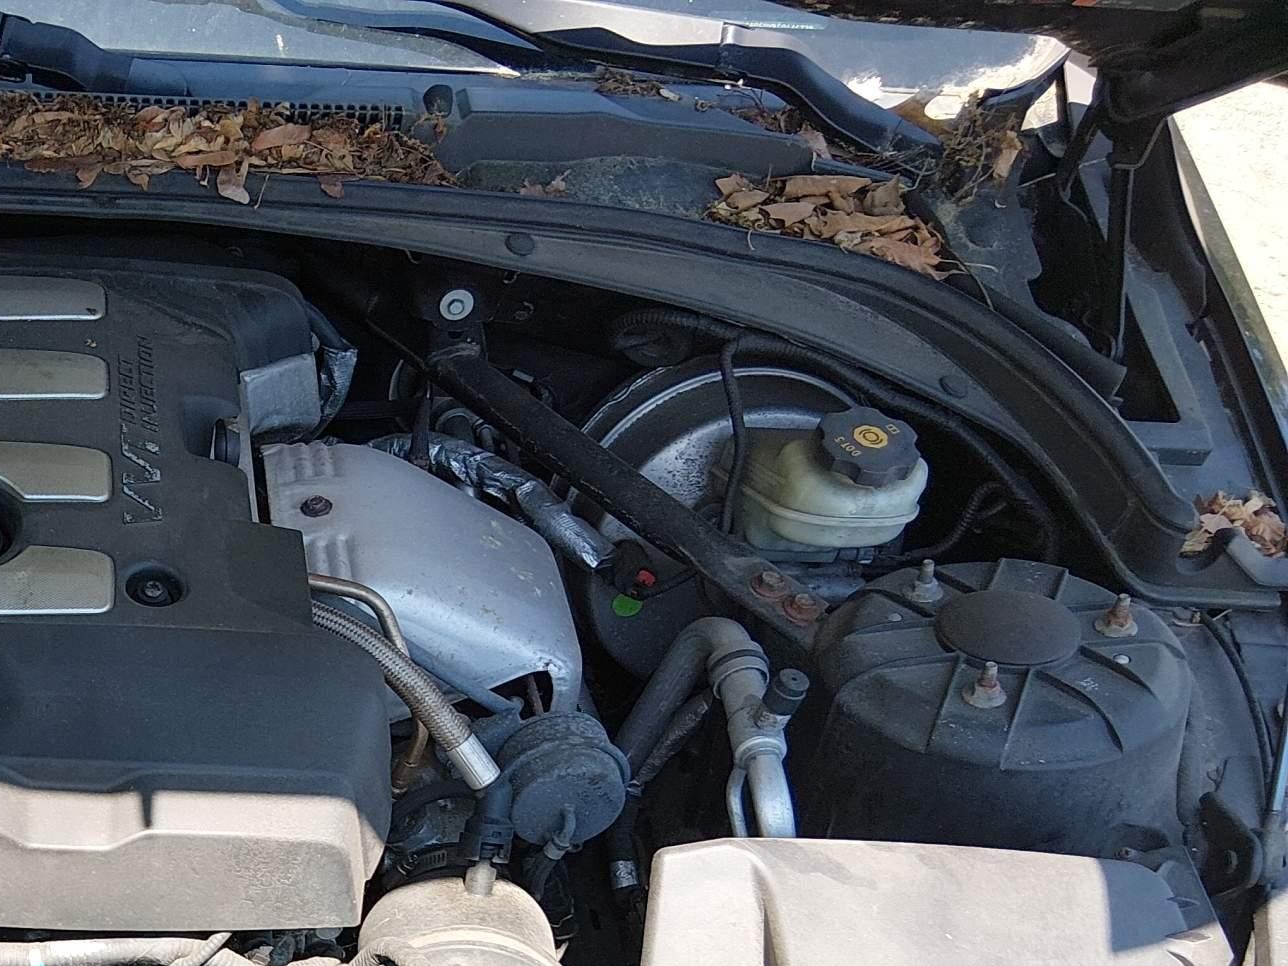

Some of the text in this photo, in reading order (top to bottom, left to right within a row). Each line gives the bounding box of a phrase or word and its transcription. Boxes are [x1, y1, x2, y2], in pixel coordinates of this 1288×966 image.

[118, 354, 137, 425] DIRECT
[136, 335, 160, 433] INJECTION
[840, 441, 862, 457] DOT
